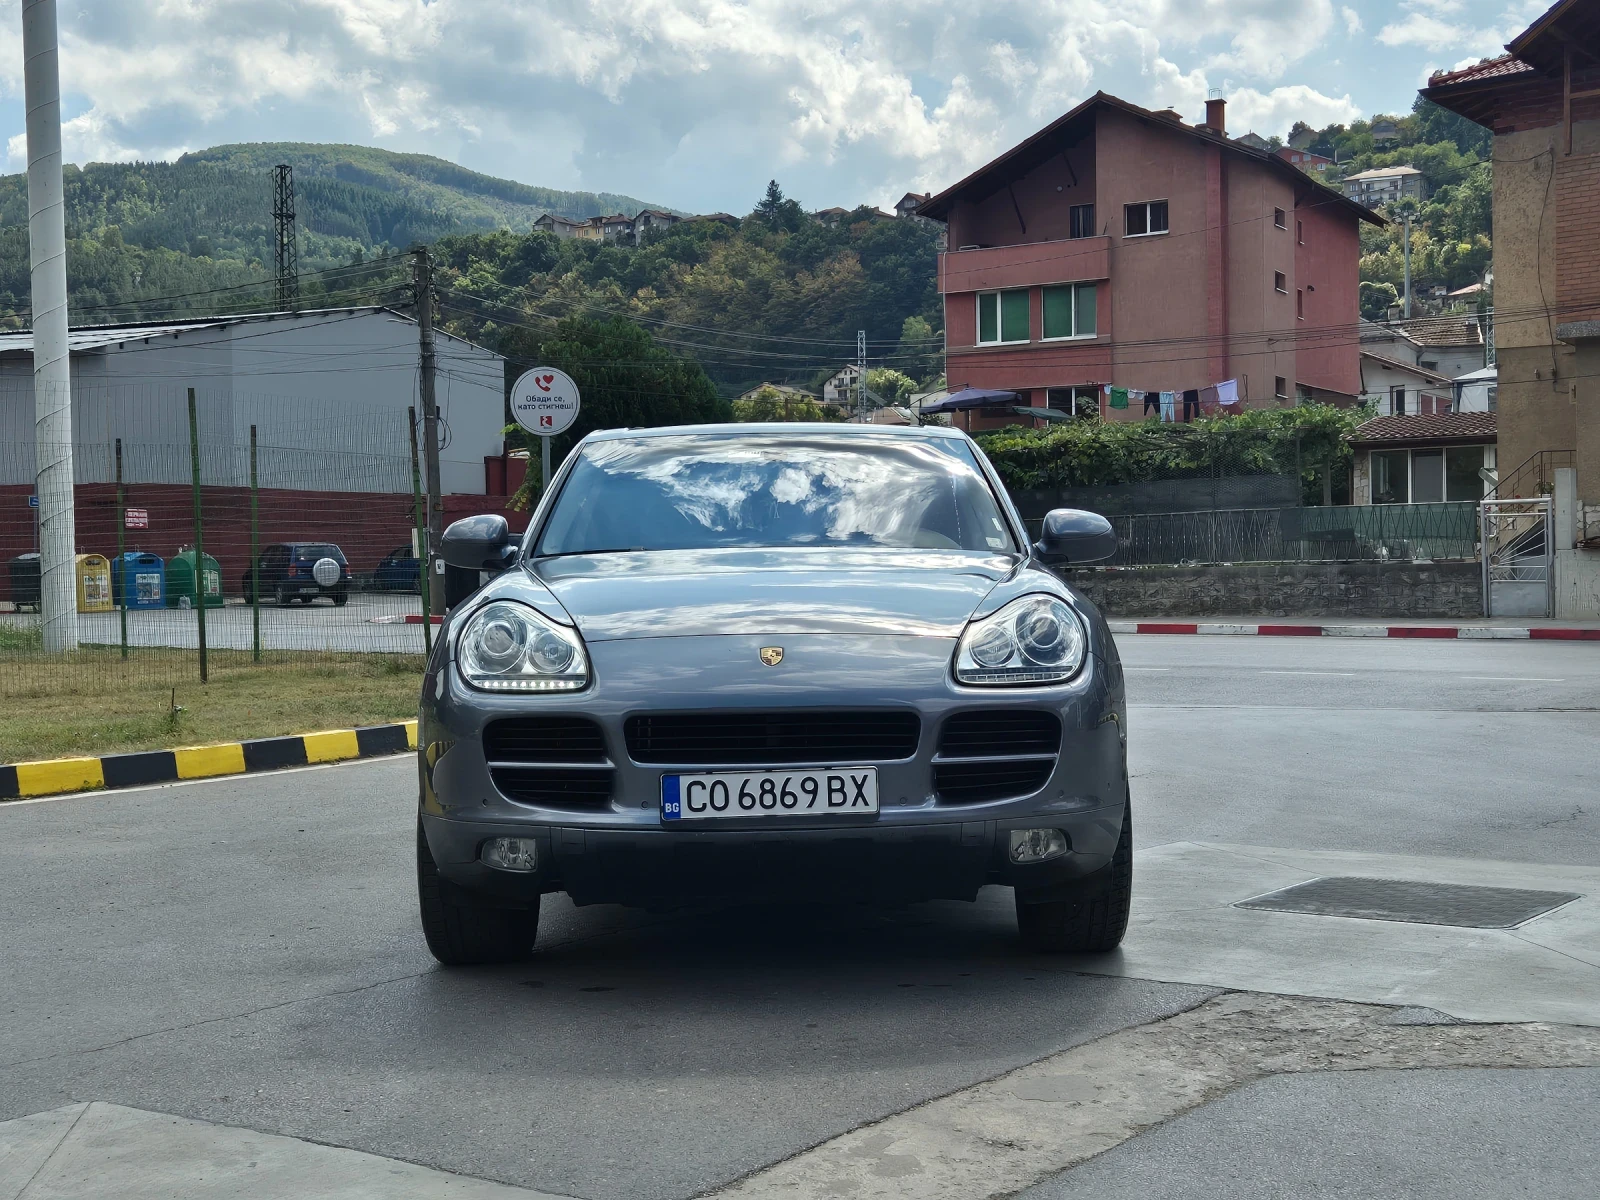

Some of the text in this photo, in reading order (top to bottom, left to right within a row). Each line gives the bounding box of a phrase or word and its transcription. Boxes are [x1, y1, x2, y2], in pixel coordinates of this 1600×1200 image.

[526, 395, 552, 403] Обади
[538, 402, 574, 410] стигнеш!
[738, 776, 819, 810] 6869
[665, 803, 680, 813] BG
